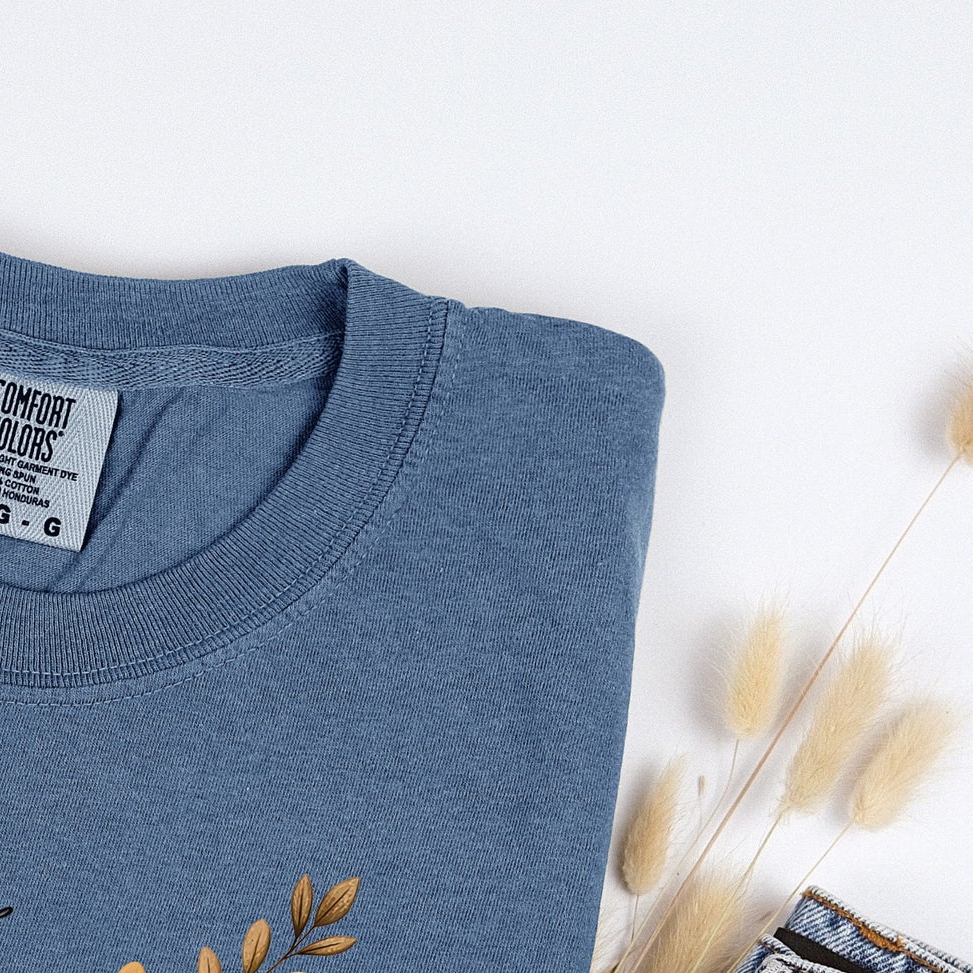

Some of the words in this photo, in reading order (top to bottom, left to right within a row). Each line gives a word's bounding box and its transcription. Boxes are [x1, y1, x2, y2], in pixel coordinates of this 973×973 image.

[12, 470, 37, 484] SPUN
[17, 460, 59, 477] GARMENT
[59, 470, 79, 482] DYE
[4, 479, 40, 495] COTTON
[2, 488, 50, 508] HONDURAS
[44, 517, 62, 537] G
